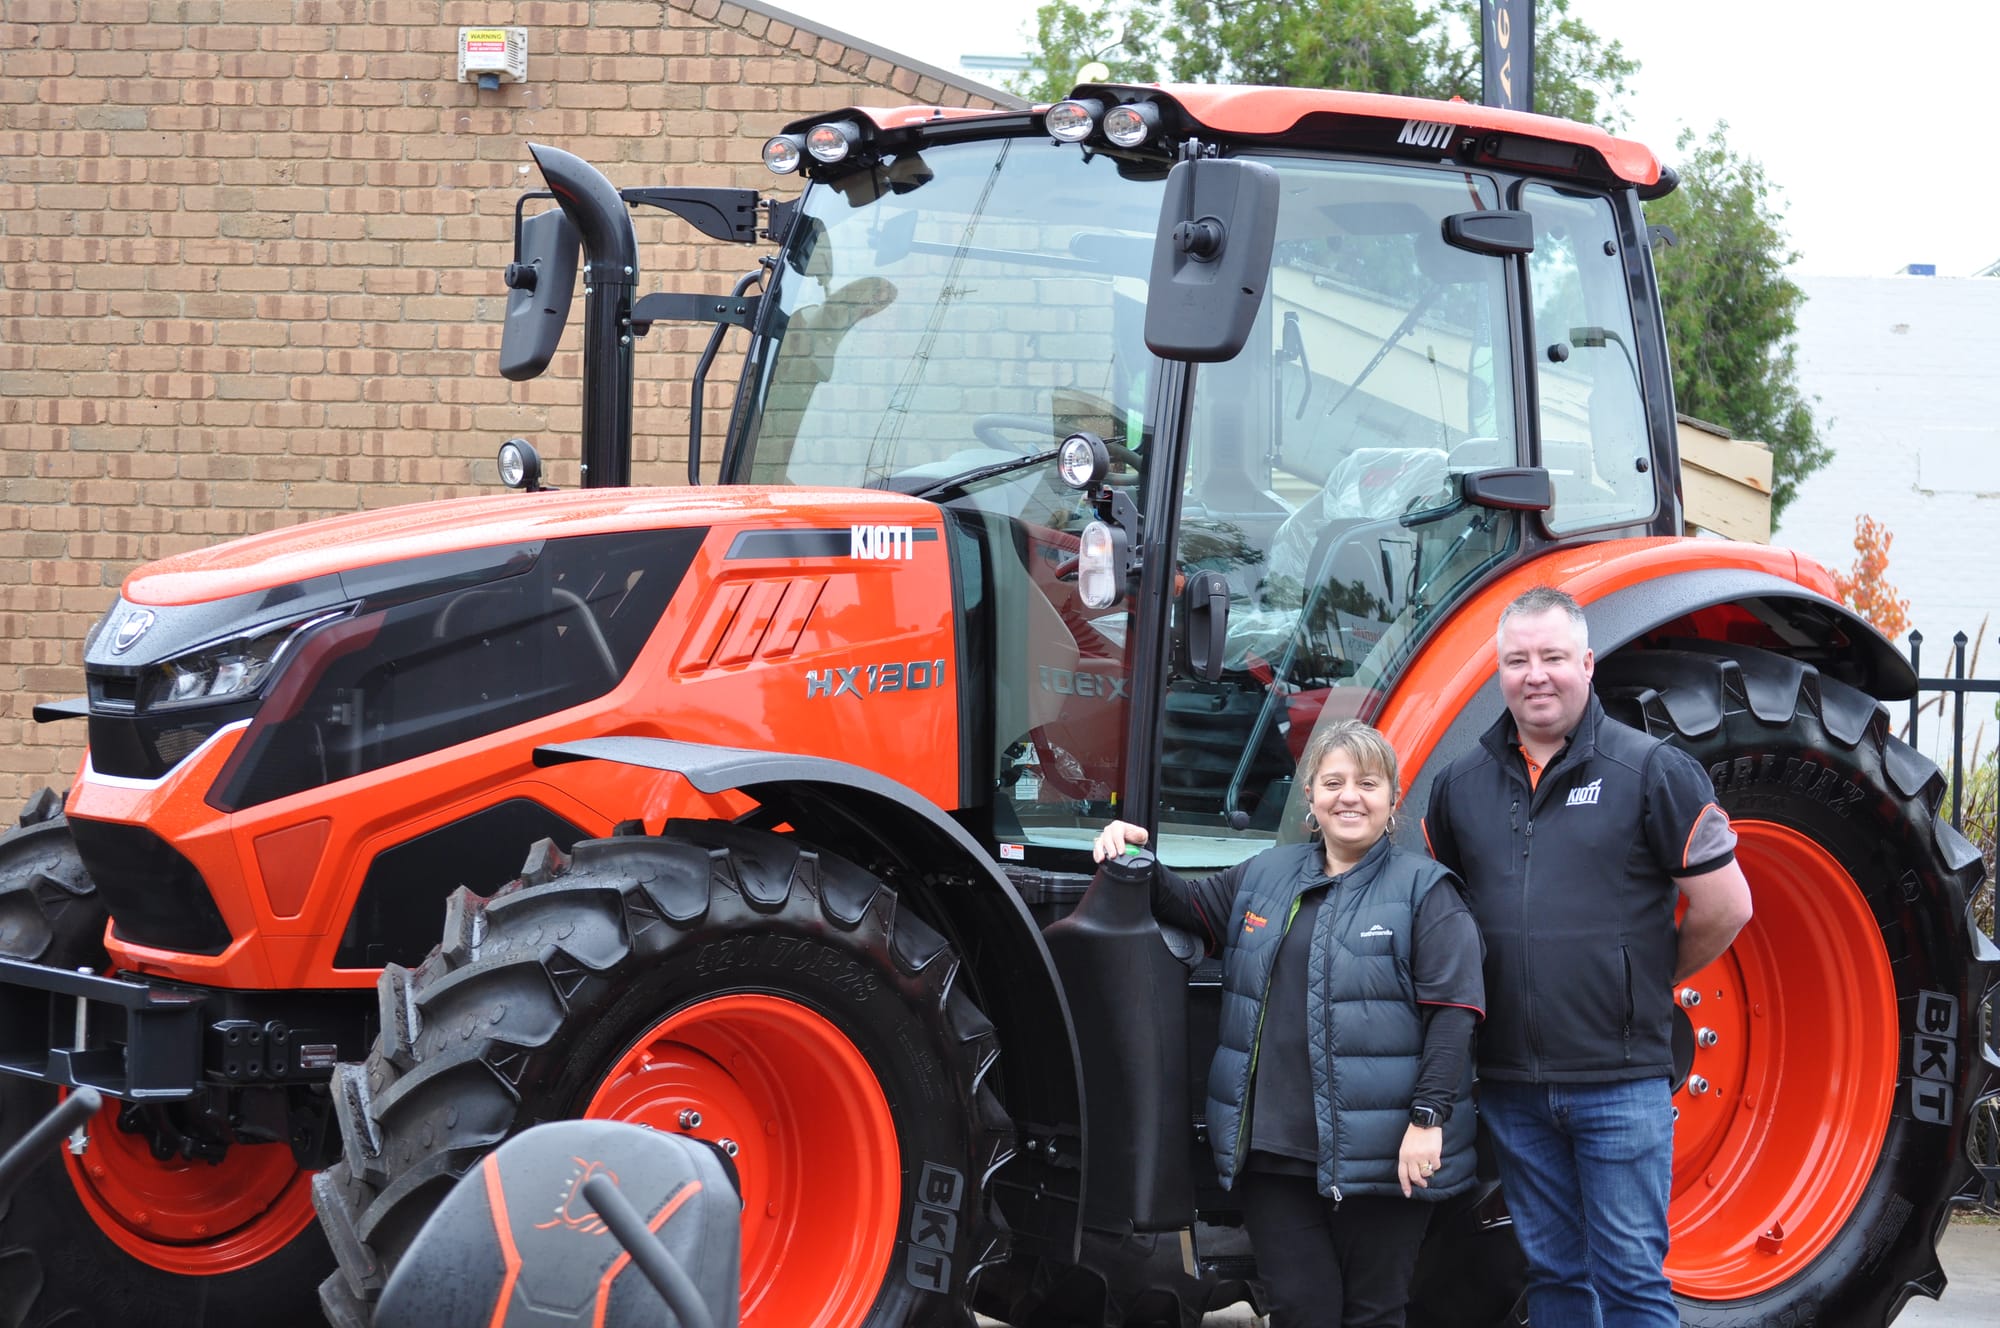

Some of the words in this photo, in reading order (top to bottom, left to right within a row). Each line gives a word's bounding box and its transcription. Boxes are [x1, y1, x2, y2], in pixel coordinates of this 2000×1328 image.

[1497, 0, 1512, 109] AG
[1397, 119, 1456, 149] KIOTI
[851, 525, 913, 560] KIOTI
[805, 659, 945, 700] HX1301
[1567, 786, 1601, 803] KIOTI
[1708, 754, 1865, 818] GRIMAX
[1915, 992, 1957, 1123] BKT
[911, 1164, 960, 1291] BKT
